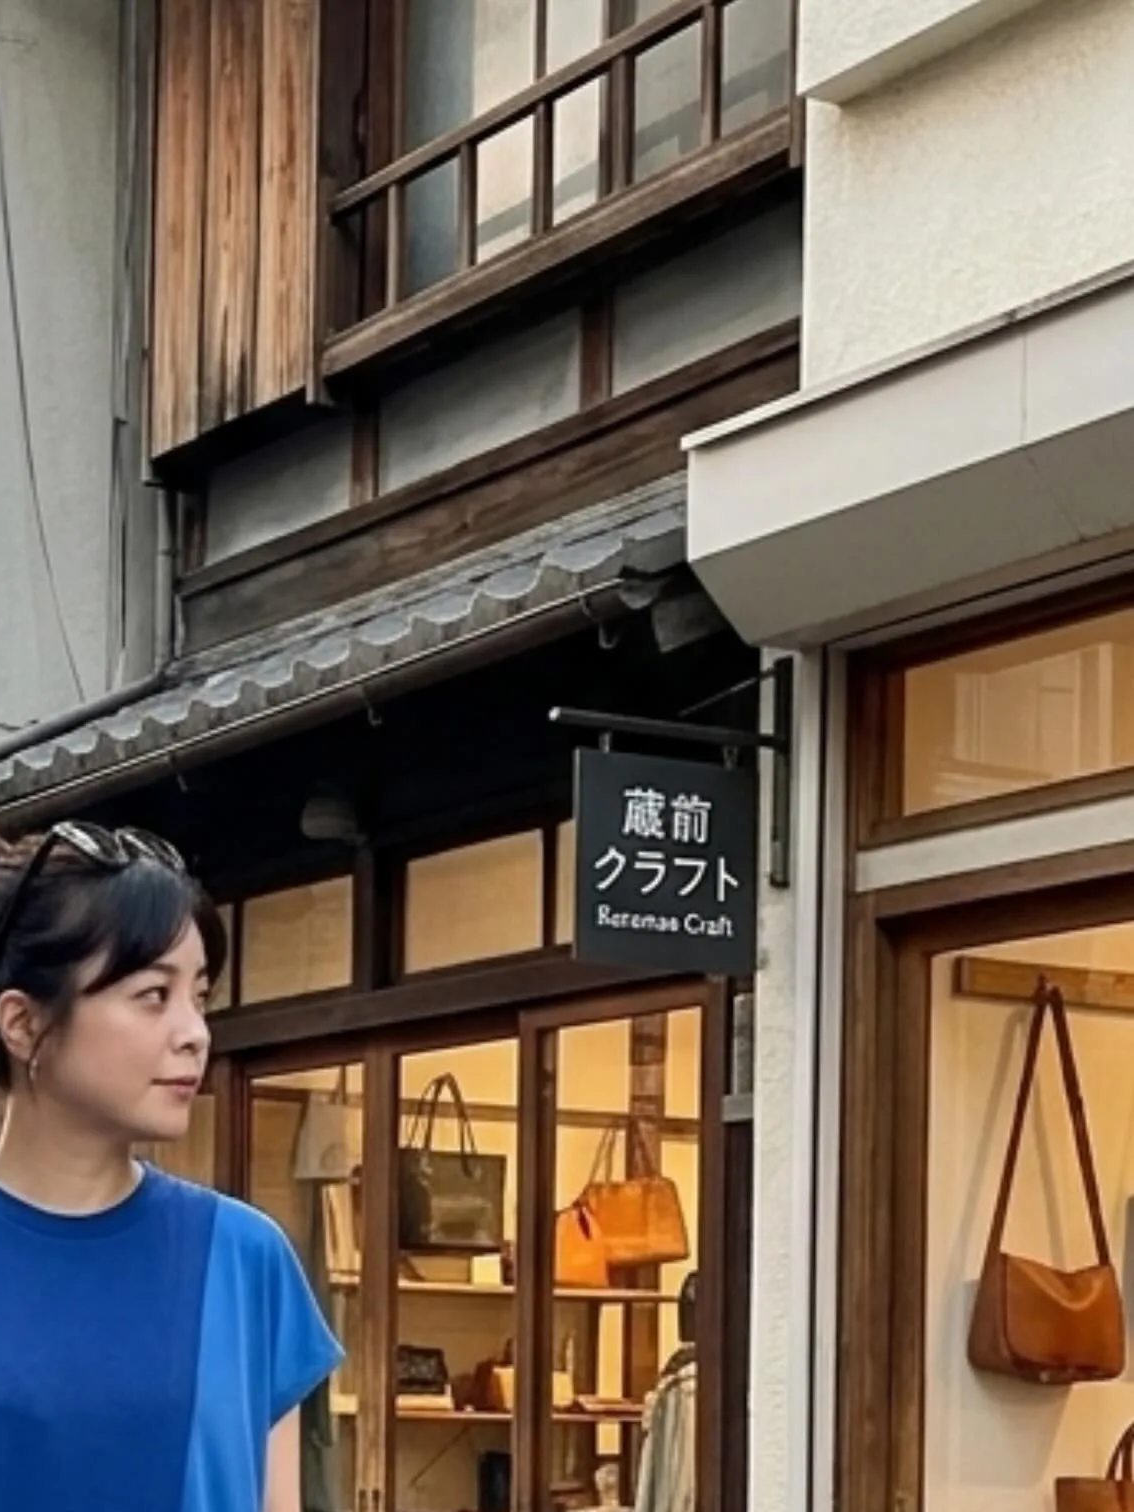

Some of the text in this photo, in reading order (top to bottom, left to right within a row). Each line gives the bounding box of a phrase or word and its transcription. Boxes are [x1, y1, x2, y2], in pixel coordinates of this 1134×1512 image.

[622, 786, 712, 843] 蔵前
[594, 845, 739, 902] クラフト
[683, 912, 734, 938] Craft
